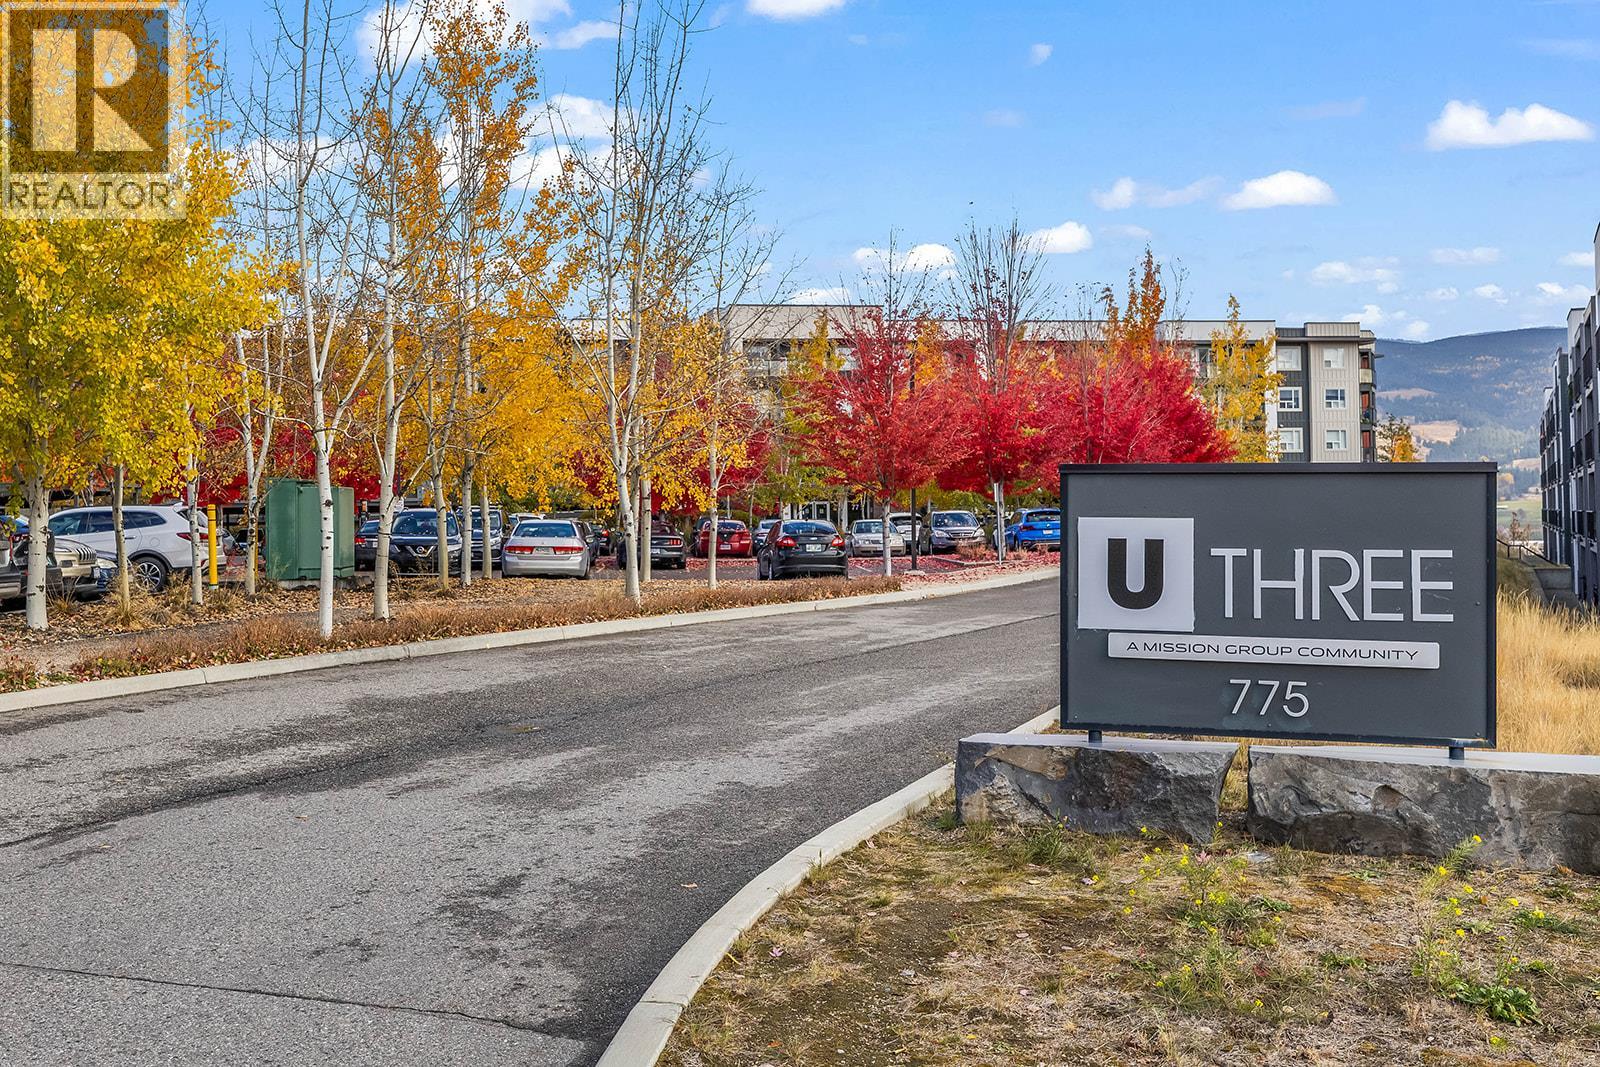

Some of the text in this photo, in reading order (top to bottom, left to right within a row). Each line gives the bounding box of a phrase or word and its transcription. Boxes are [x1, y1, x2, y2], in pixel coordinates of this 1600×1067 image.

[1107, 537, 1454, 622] U THREE
[1126, 641, 1418, 660] A MISSION GROUP COMMUNITY
[1229, 679, 1310, 718] 775
